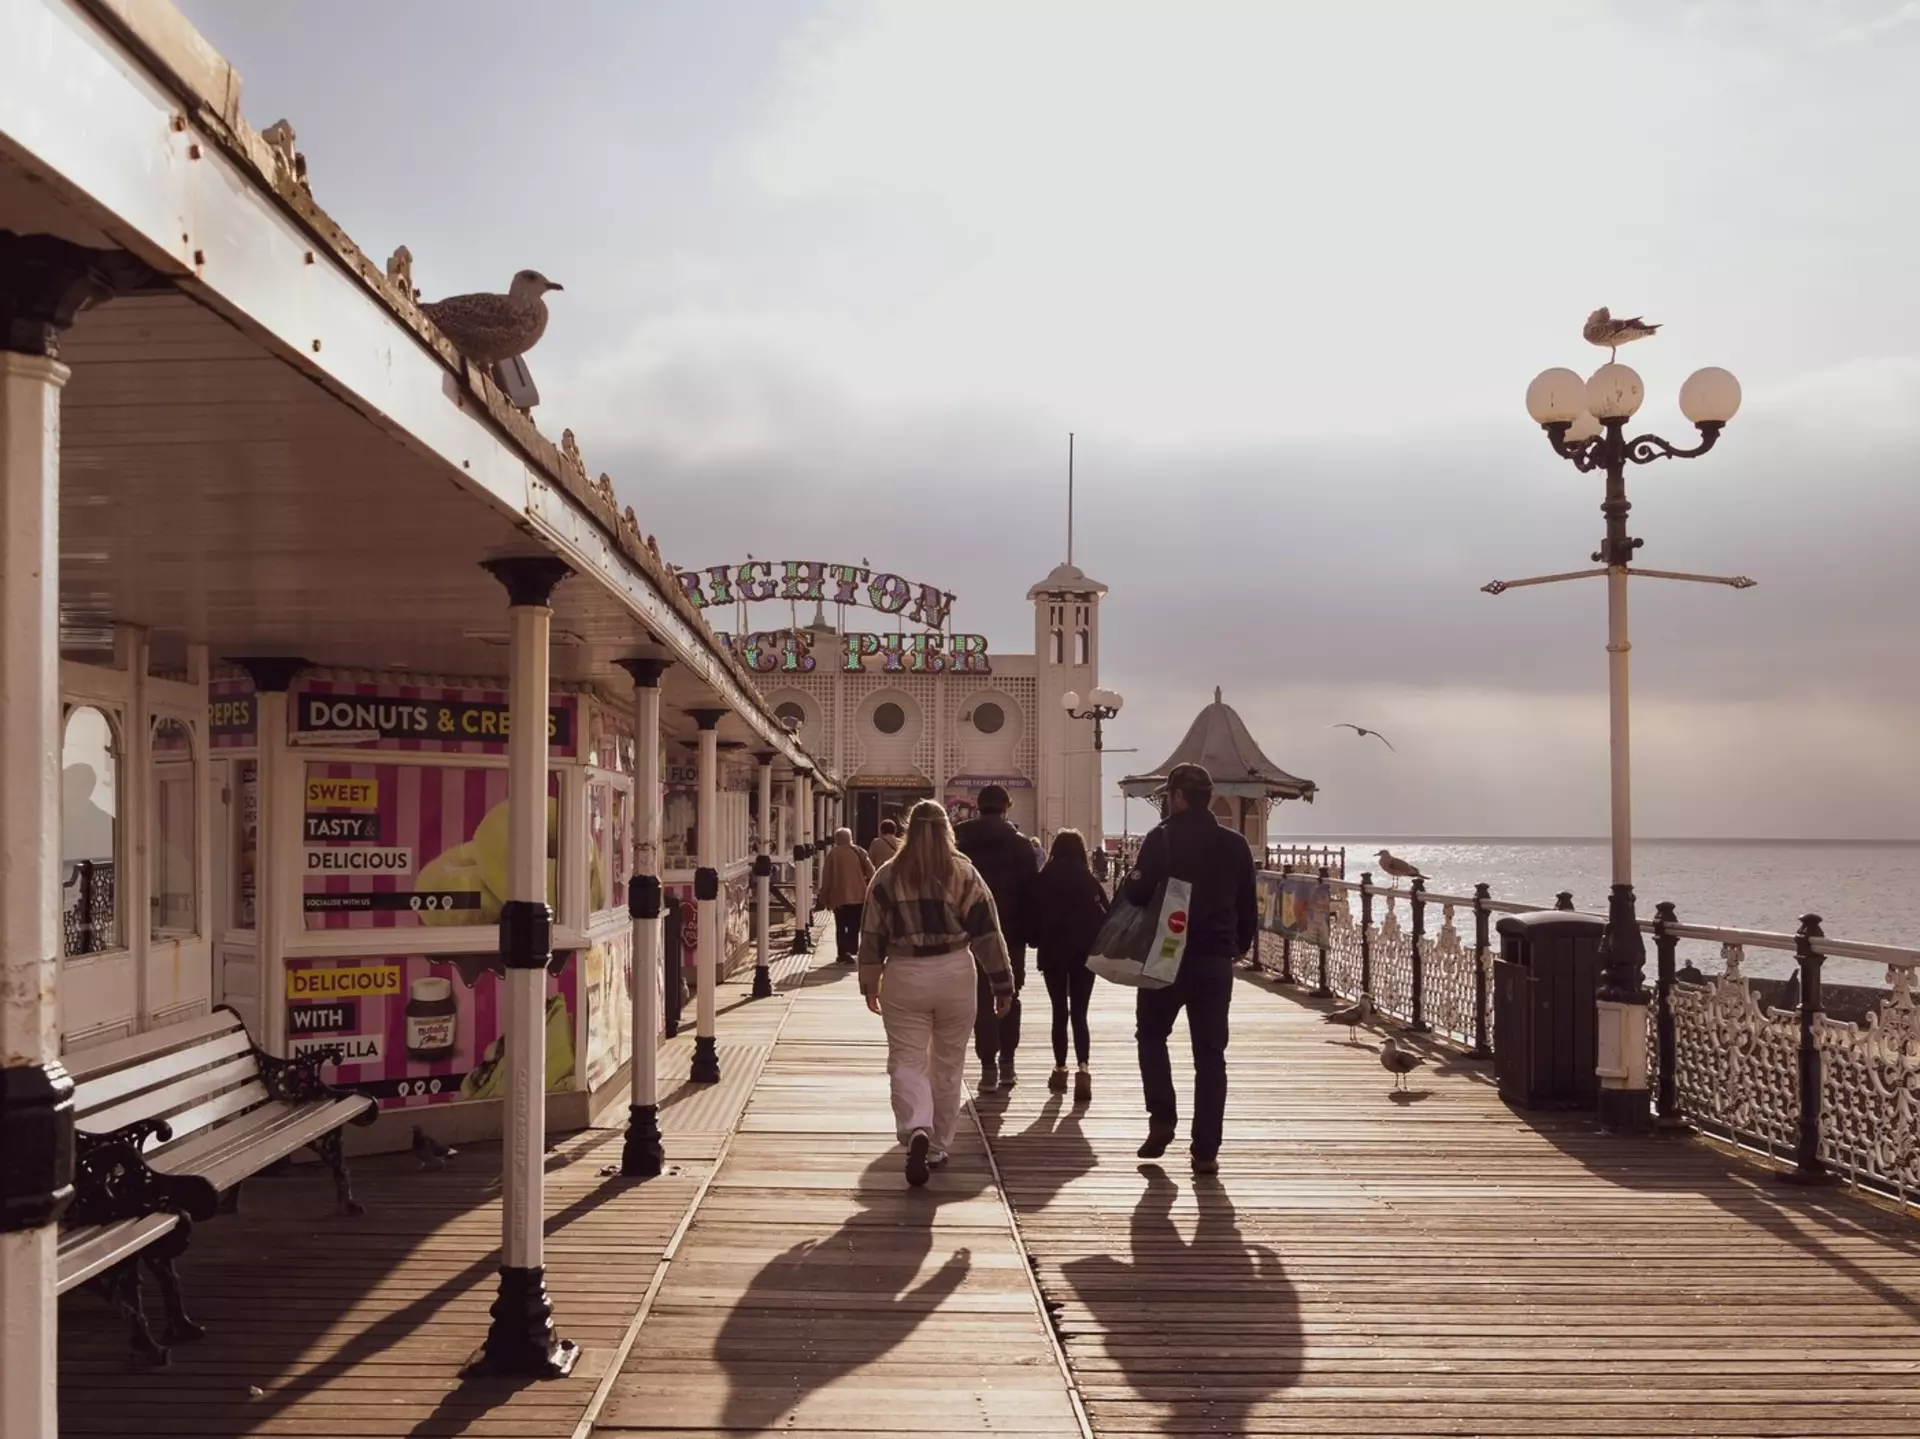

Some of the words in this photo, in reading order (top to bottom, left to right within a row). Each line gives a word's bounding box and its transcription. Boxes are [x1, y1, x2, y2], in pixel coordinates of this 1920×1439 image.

[843, 632, 992, 675] PIER
[309, 701, 428, 731] DONUTS
[437, 708, 455, 732] &
[461, 709, 557, 738] CRES
[672, 766, 699, 781] FLO
[309, 784, 370, 801] SWEET
[307, 819, 363, 836] TASTY
[364, 822, 376, 837] &
[307, 852, 408, 869] DELICIOUS
[342, 898, 360, 906] WITH
[361, 897, 370, 906] US
[294, 971, 397, 993] DELICIOUS
[294, 1009, 343, 1028] WITH
